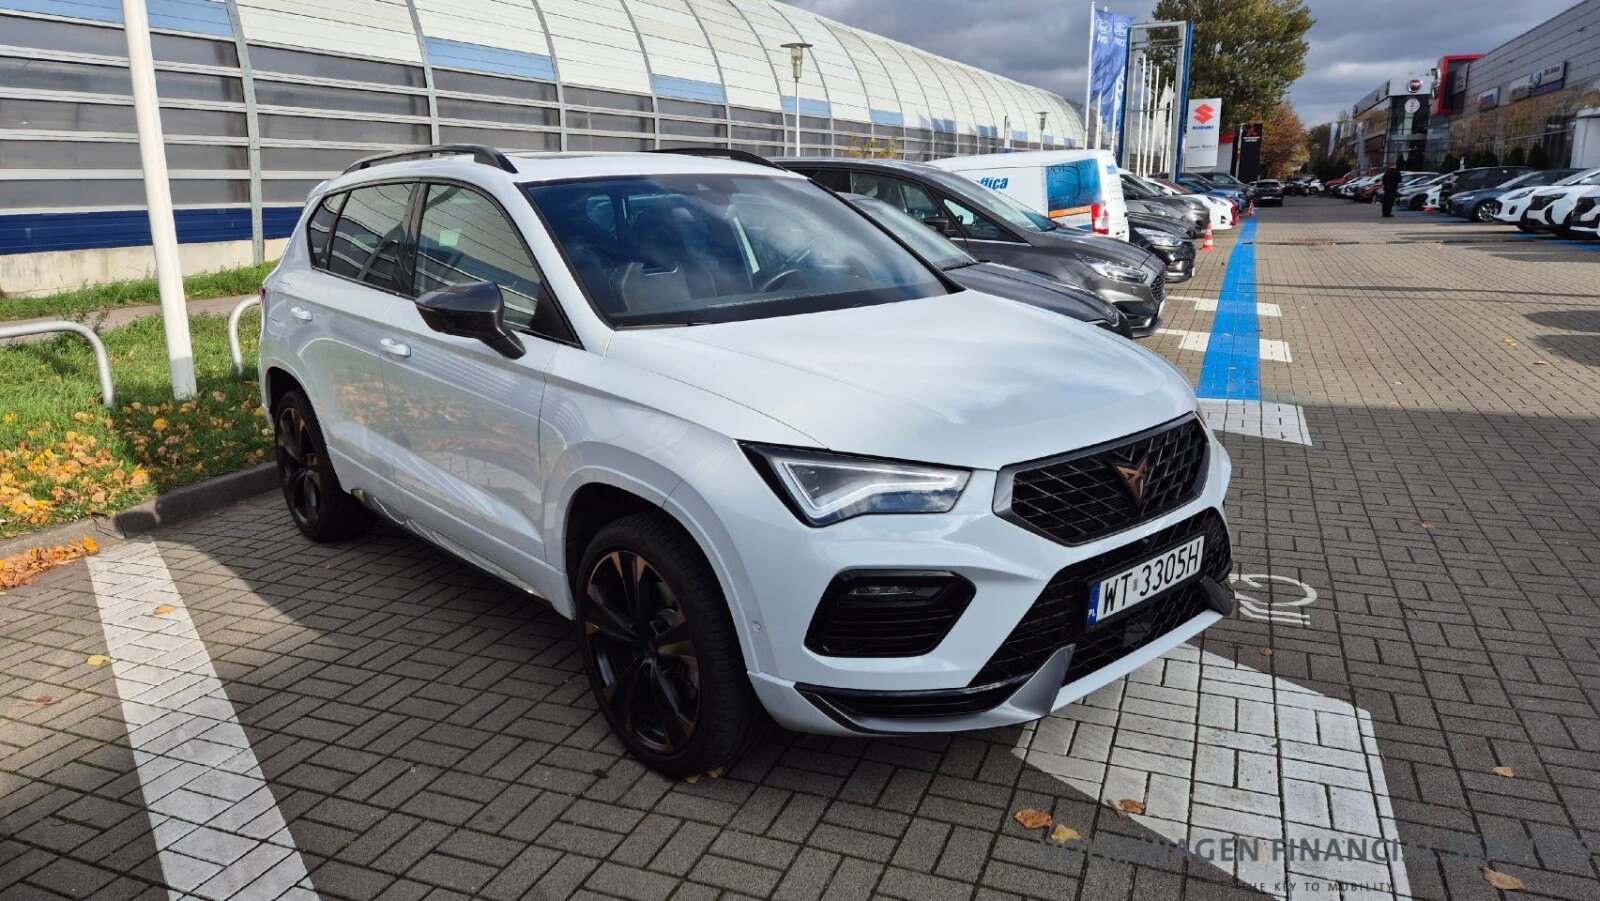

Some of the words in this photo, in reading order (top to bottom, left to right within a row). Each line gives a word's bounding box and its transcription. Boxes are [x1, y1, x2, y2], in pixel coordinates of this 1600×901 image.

[1103, 572, 1133, 615] WT
[1140, 541, 1201, 597] 3305H
[1087, 608, 1096, 617] PL
